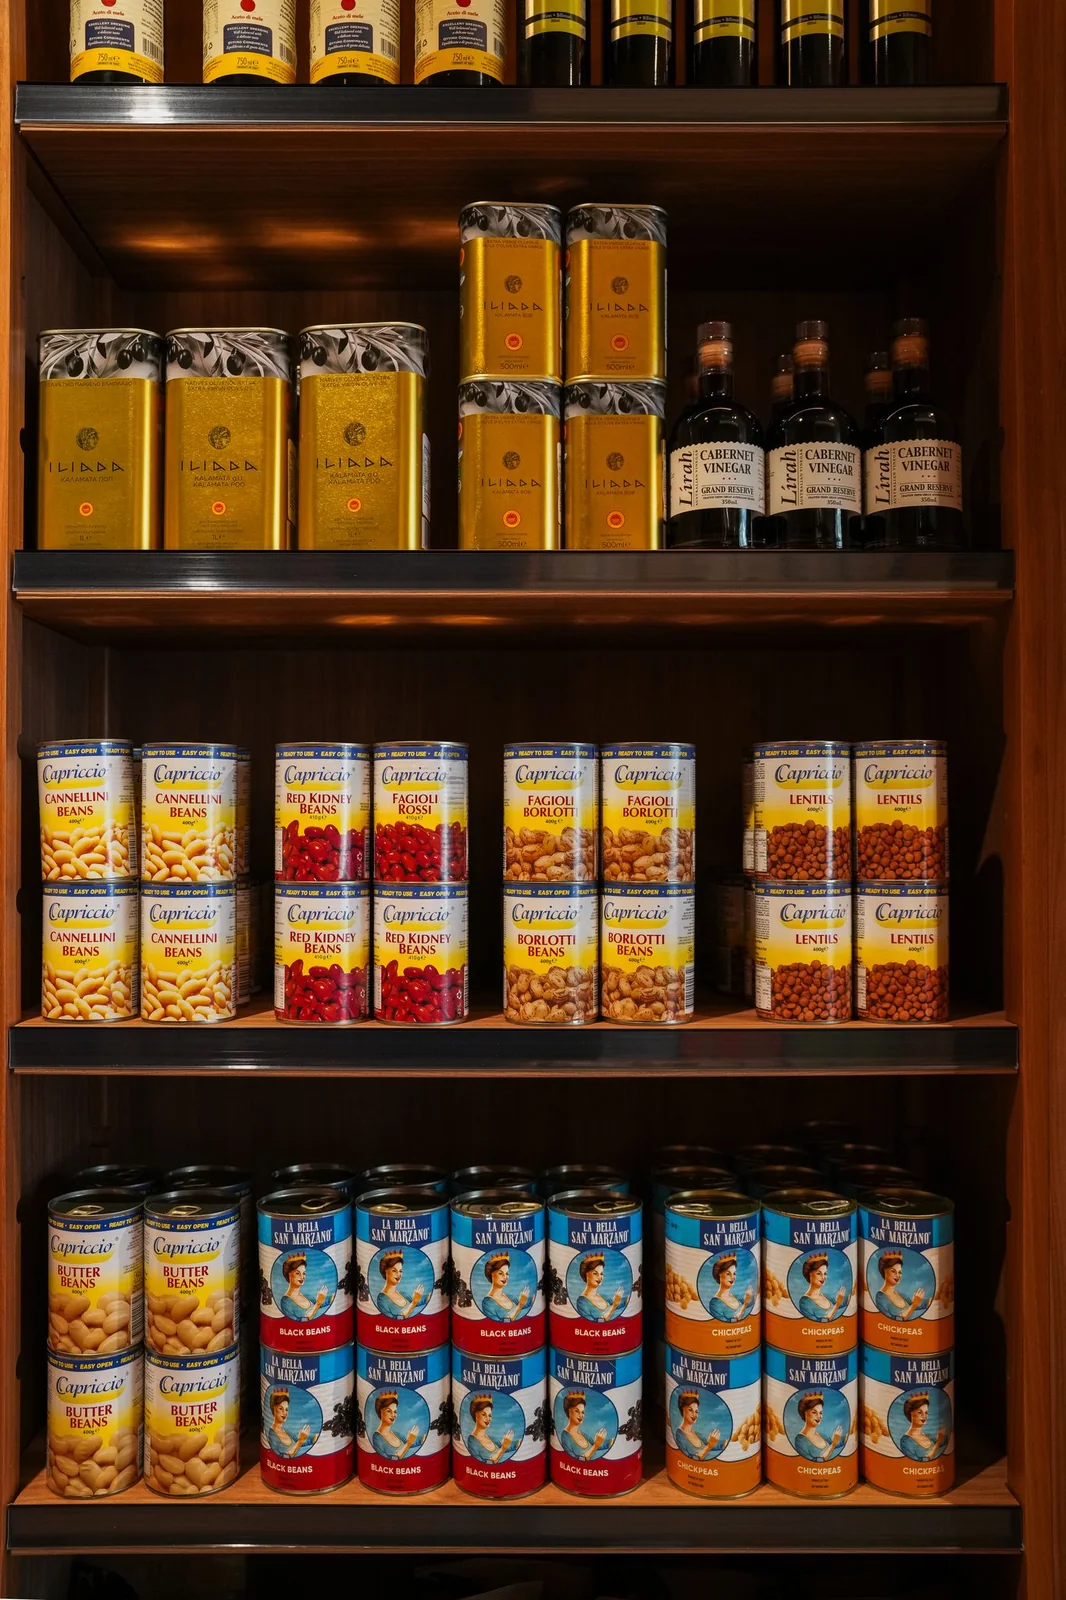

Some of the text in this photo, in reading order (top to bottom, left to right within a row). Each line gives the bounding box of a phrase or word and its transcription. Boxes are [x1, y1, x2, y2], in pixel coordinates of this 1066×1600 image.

[98, 53, 108, 62] 750
[484, 302, 543, 312] ILIADA
[590, 303, 649, 312] ILIADA
[700, 449, 754, 462] CABERNET
[805, 449, 856, 463] CABERNET
[898, 447, 953, 459] CABERNET
[50, 462, 125, 473] ILIADA
[181, 460, 258, 472] ILIADA
[316, 457, 393, 469] ILIADA
[704, 462, 751, 475] VINEGAR
[902, 460, 950, 472] VINEGAR
[809, 463, 853, 476] VINEGAR
[481, 478, 542, 488] ILIADA
[585, 479, 645, 489] ILIADA
[900, 484, 953, 493] GRAND RESERVE
[702, 486, 754, 495] GRAND RESERVE
[806, 486, 856, 497] GRAND RESERVE
[43, 763, 107, 784] Capriccio
[154, 764, 222, 784] Capriccio
[285, 765, 351, 785] Capriccio
[382, 765, 447, 785] Capriccio
[516, 765, 583, 784] Capriccio
[614, 765, 682, 784] Capriccio
[775, 763, 843, 783] Capriccio
[864, 763, 933, 783] Capriccio
[45, 792, 109, 804] CANNELLINI
[155, 793, 222, 805] CANNELLINI
[287, 793, 352, 804] RED KIDNEY
[393, 794, 438, 804] FAGIOLI
[528, 795, 574, 806] FAGIOLI
[628, 796, 674, 806] FAGIOLI
[790, 794, 834, 805] LENTILS
[877, 794, 923, 805] LENTILS
[57, 806, 94, 817] BEANS
[170, 807, 207, 818] BEANS
[300, 804, 337, 815] BEANS
[398, 804, 432, 815] ROSSI
[524, 807, 579, 818] BORLOTTI
[623, 808, 678, 818] BORLOTTI
[49, 902, 115, 924] Capriccio
[150, 903, 217, 924] Capriccio
[288, 904, 356, 924] Capriccio
[383, 904, 450, 925] Capriccio
[512, 903, 578, 924] Capriccio
[604, 902, 668, 923] Capriccio
[780, 903, 845, 923] Capriccio
[876, 903, 942, 923] Capriccio
[50, 931, 116, 943] CANNELLINI
[151, 932, 218, 944] CANNELLINI
[290, 932, 356, 943] RED KIDNEY
[385, 932, 451, 944] RED KIDNEY
[518, 935, 576, 945] BORLOTTI
[608, 933, 665, 945] BORLOTTI
[796, 934, 838, 945] LENTILS
[891, 934, 934, 944] LENTILS
[63, 946, 100, 957] BEANS
[165, 947, 202, 958] BEANS
[304, 944, 342, 954] BEANS
[399, 944, 436, 955] BEANS
[528, 947, 565, 957] BEANS
[617, 945, 653, 956] BEANS
[285, 1222, 319, 1233] LA BELLA
[382, 1219, 416, 1230] LA BELLA
[488, 1221, 522, 1232] LA BELLA
[583, 1222, 617, 1233] LA BELLA
[717, 1221, 748, 1234] LA BELLA
[807, 1221, 840, 1233] LA BELLA
[882, 1219, 916, 1232] LA BELLA
[275, 1230, 332, 1247] SAN MARZANO
[372, 1228, 429, 1245] SAN MARZANO
[476, 1231, 533, 1248] SAN MARZANO
[571, 1231, 629, 1248] SAN MARZANO
[704, 1230, 756, 1247] SAN MARZANO
[794, 1230, 850, 1247] SAN MARZANO
[870, 1227, 930, 1247] SAN MARZANO
[51, 1234, 113, 1258] Capriccio
[154, 1235, 220, 1258] Capriccio
[58, 1265, 101, 1278] BUTTER
[163, 1265, 209, 1278] BUTTER
[61, 1277, 96, 1289] BEANS
[167, 1277, 205, 1288] BEANS
[280, 1326, 331, 1336] BLACK BEANS
[376, 1325, 427, 1334] BLACK BEANS
[481, 1327, 532, 1337] BLACK BEANS
[575, 1328, 626, 1337] BLACK BEANS
[712, 1325, 752, 1336] CHICKPEAS
[802, 1326, 845, 1336] CHICKPEAS
[878, 1323, 923, 1336] CHICKPEAS
[56, 1375, 123, 1398] Capriccio
[159, 1373, 228, 1397] Capriccio
[66, 1404, 113, 1418] BUTTER
[171, 1401, 217, 1416] BUTTER
[70, 1417, 108, 1429] BEANS
[175, 1414, 213, 1427] BEANS
[267, 1460, 313, 1474] BLACK BEANS
[371, 1464, 421, 1475] BLACK BEANS
[466, 1466, 517, 1480] BLACK BEANS
[559, 1462, 609, 1477] BLACK BEANS
[677, 1460, 719, 1476] CHICKPEAS
[797, 1466, 842, 1475] CHICKPEAS
[903, 1465, 945, 1475] CHICKPEAS
